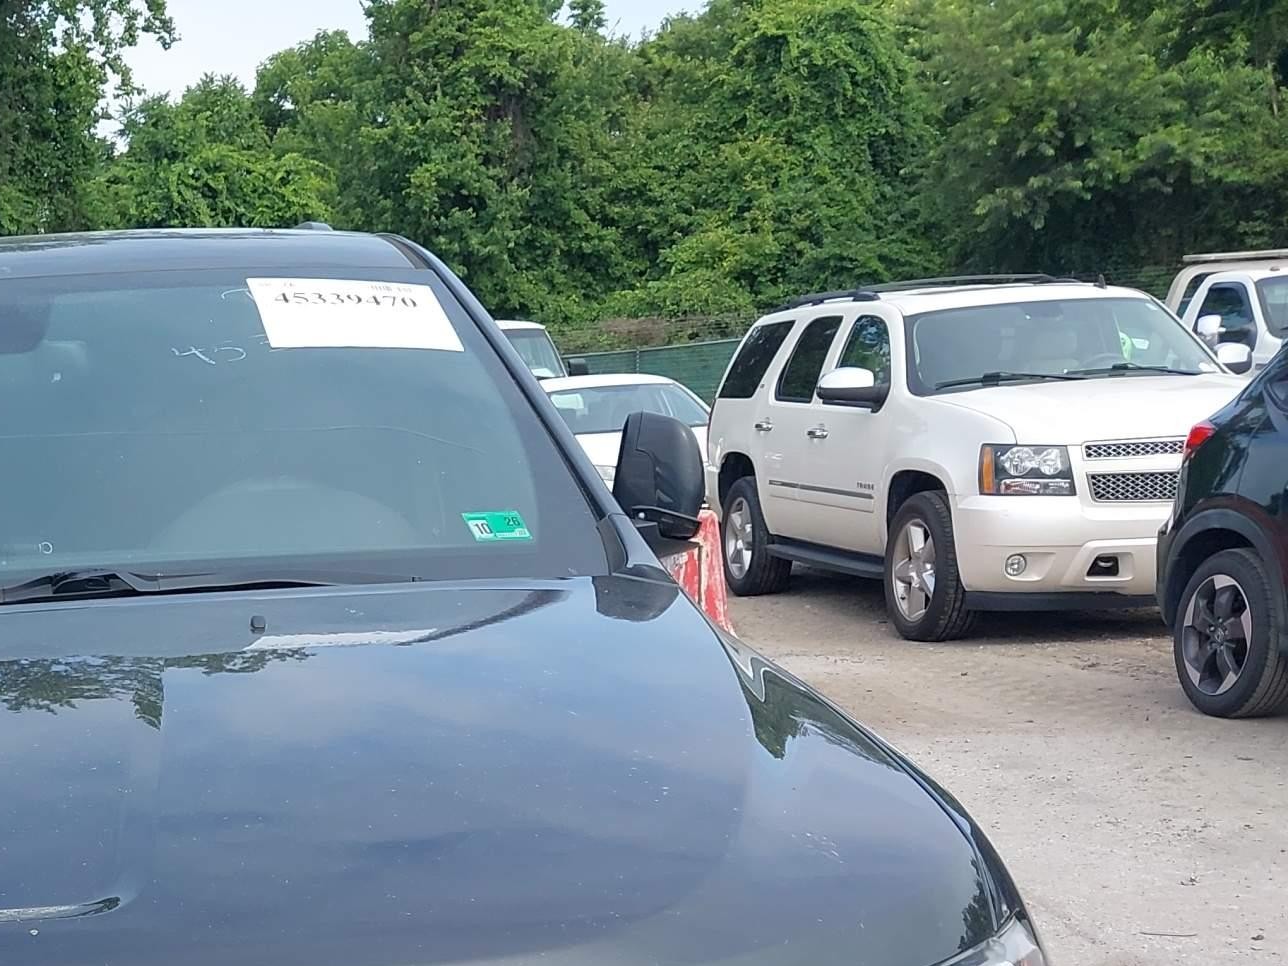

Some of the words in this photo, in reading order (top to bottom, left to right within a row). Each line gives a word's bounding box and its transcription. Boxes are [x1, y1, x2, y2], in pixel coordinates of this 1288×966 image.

[274, 291, 419, 309] 45339470
[504, 516, 521, 527] 26
[473, 522, 494, 535] 10
